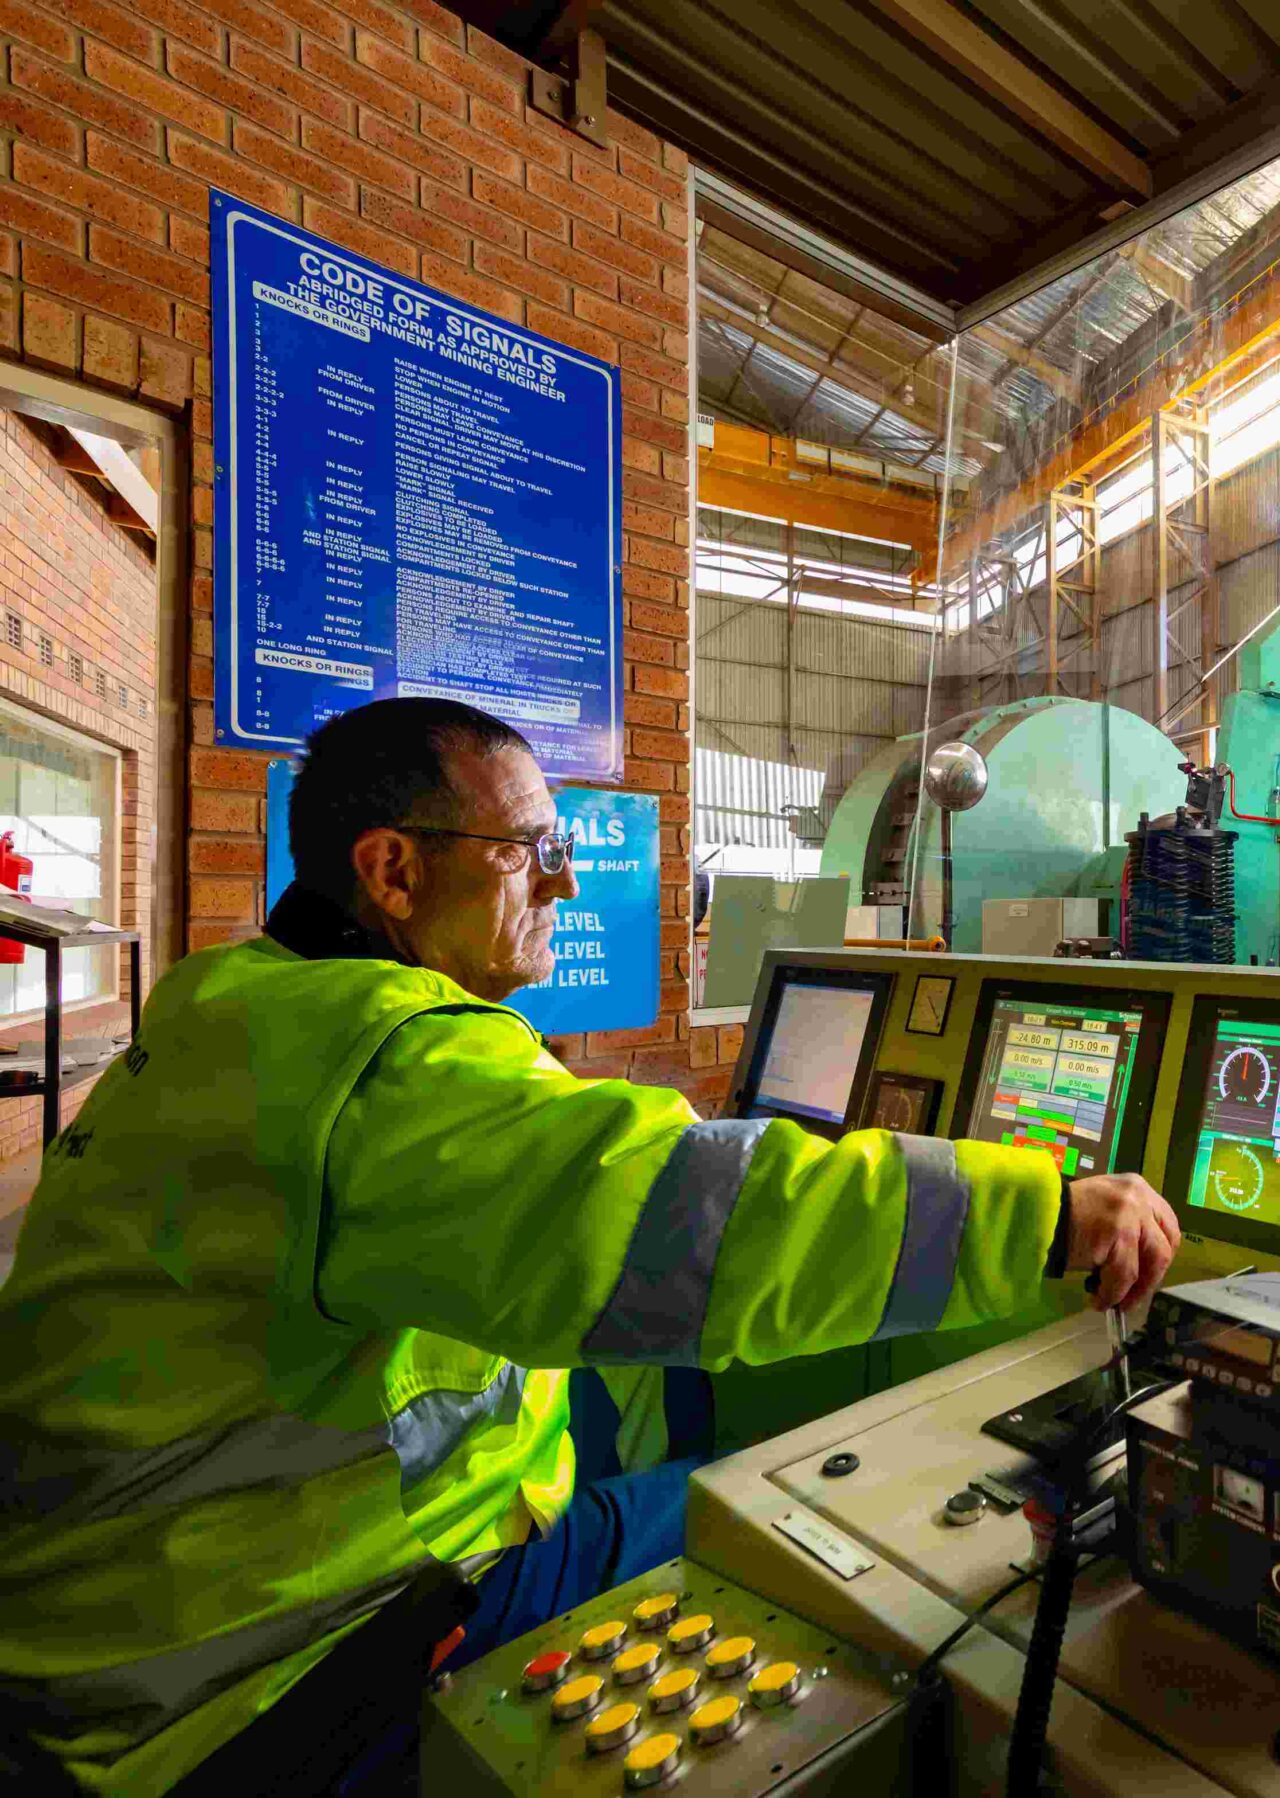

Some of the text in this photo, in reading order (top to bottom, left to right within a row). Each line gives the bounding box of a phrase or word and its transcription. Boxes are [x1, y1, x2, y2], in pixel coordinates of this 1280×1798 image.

[260, 288, 366, 337] KNOCKS OR RINGS
[299, 252, 556, 374] CODE OF SIGNALS
[286, 282, 566, 402] THE GOVERNMENT MINING ENGINEER
[298, 275, 557, 387] ABRIDGED FORM AS APPROVED BY
[318, 368, 375, 394] FROM DRIVER
[326, 364, 363, 382] IN REPLY
[394, 357, 417, 371] RAISE
[419, 367, 442, 380] WHEN
[443, 376, 472, 392] ENGINE
[484, 391, 503, 402] REST
[395, 374, 422, 388] LOWER
[318, 386, 375, 411] FROM DRIVER
[394, 366, 416, 378] STOP
[417, 374, 440, 388] WHEN
[442, 384, 470, 399] ENGINE
[481, 398, 510, 413] MOTION
[326, 398, 364, 416] IN REPLY
[394, 381, 499, 424] PERSONS ABOUT TO TRAVEL
[327, 429, 364, 445] IN REPLY
[394, 401, 421, 417] CLEAR
[454, 424, 482, 438] DRIVER
[483, 434, 498, 443] MAY
[500, 439, 520, 451] MOVE
[545, 455, 586, 472] DISCRETION
[394, 413, 528, 463] PERSONS MUST LEAVE CONVEYANCE
[395, 422, 407, 431] NO
[409, 427, 446, 444] PERSONS
[456, 443, 505, 463] CONVEYANCE
[395, 431, 498, 469] CANCEL OR REPEAT SIGNAL
[326, 460, 362, 476] IN REPLY
[395, 441, 552, 495] PERSONS GIVING SIGNAL ABOUT TO TRAVEL
[319, 494, 376, 516] FROM DRIVER
[428, 491, 456, 504] SIGNAL
[457, 499, 494, 514] RECEIVED
[396, 539, 491, 568] COMPARTMENTS LOCKED
[326, 594, 362, 607] IN REPLY
[256, 638, 326, 656] ONE LONG RING
[306, 635, 394, 656] AND STATION SIGNAL
[263, 653, 370, 678] KNOCKS OR RINGS
[598, 860, 640, 872] SHAFT
[556, 912, 605, 932] LEVEL
[554, 941, 606, 960] LEVEL
[558, 968, 610, 987] LEVEL
